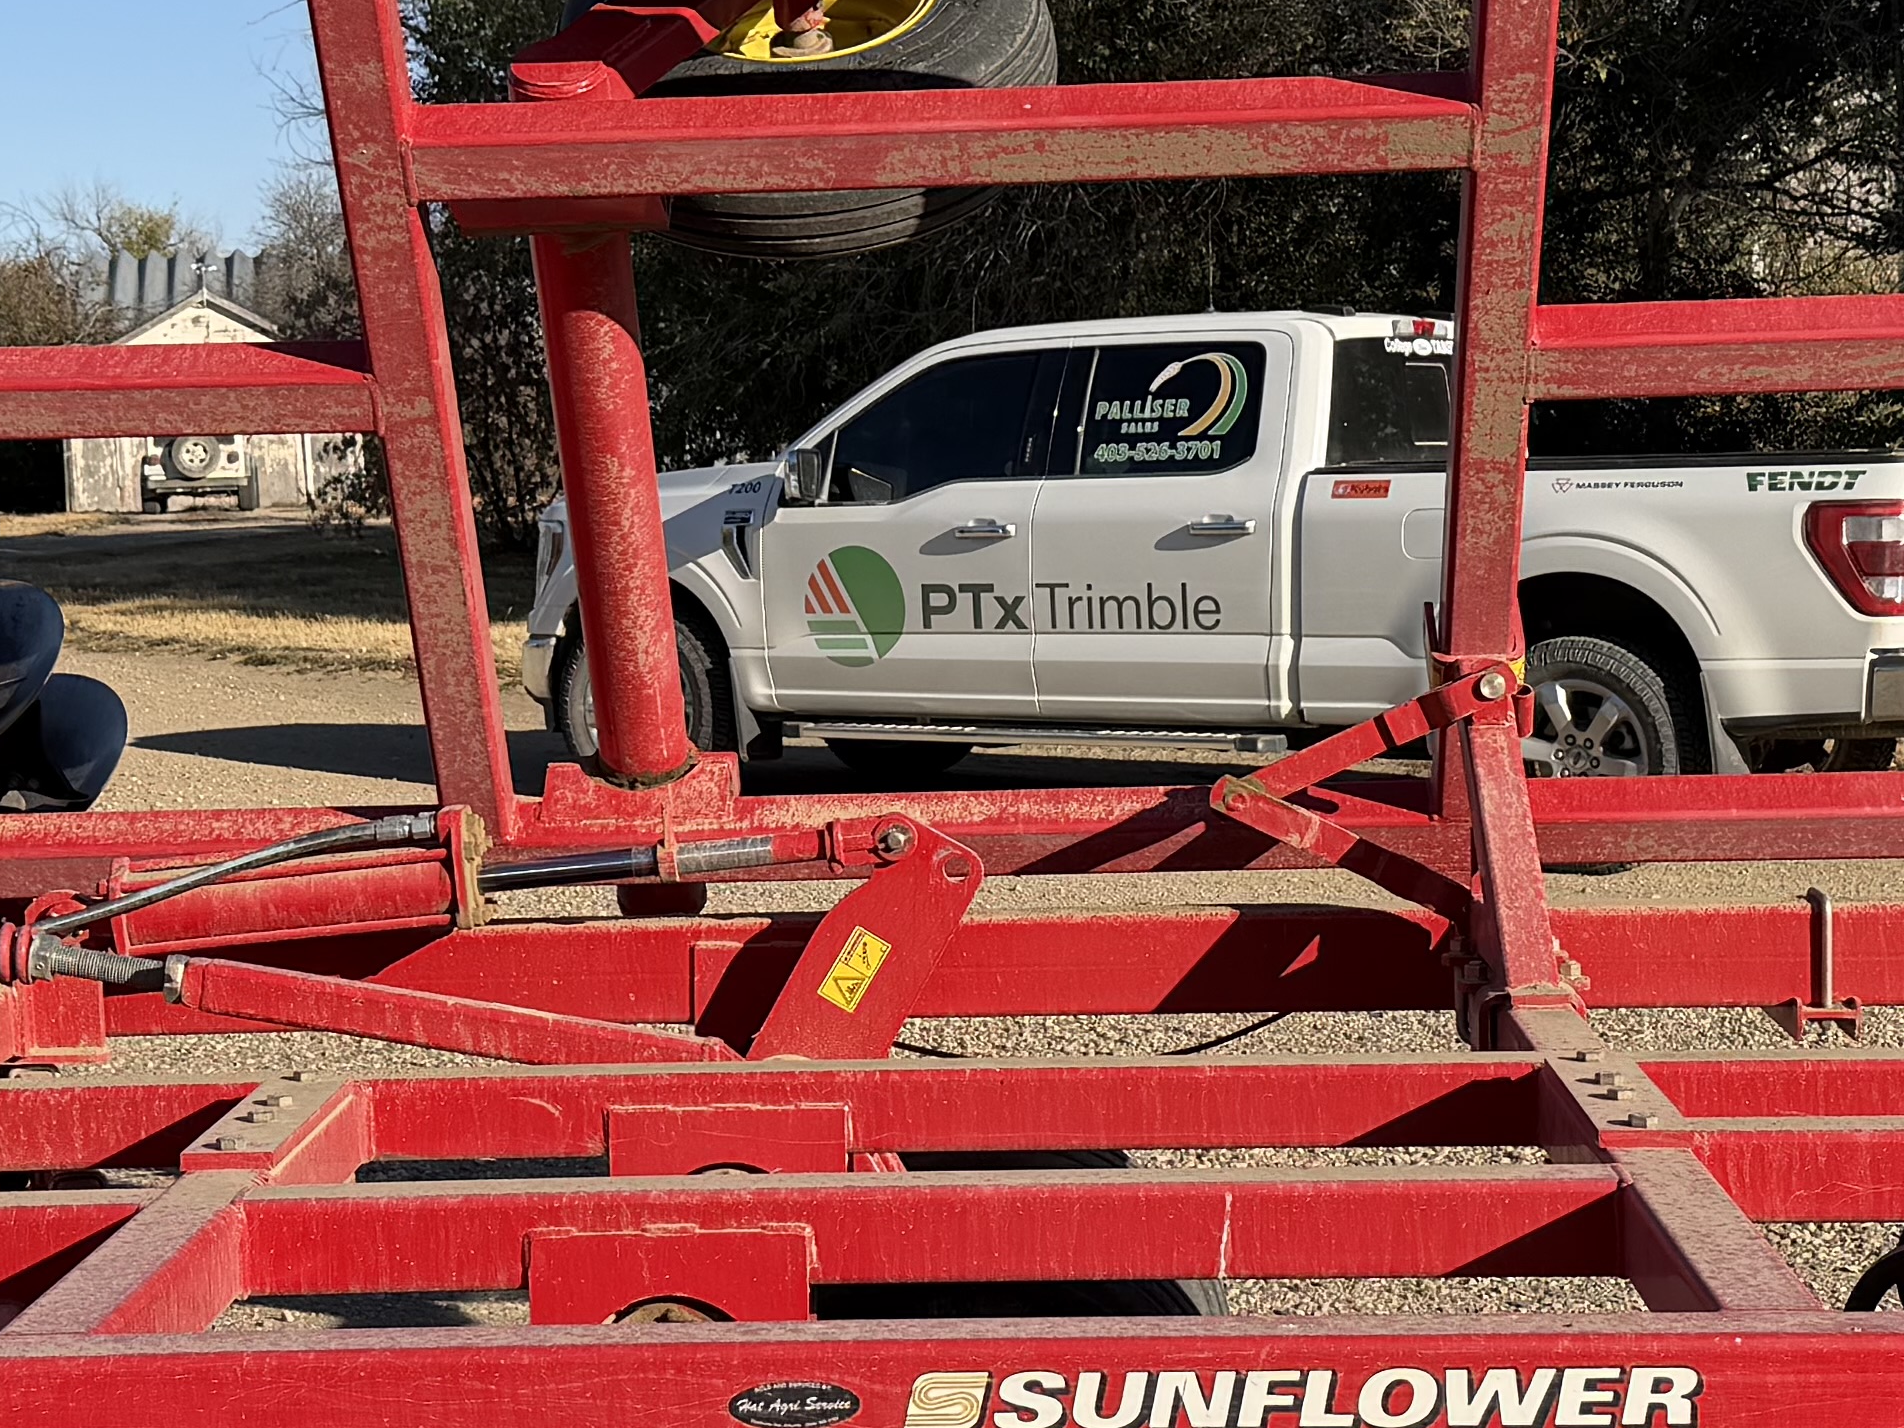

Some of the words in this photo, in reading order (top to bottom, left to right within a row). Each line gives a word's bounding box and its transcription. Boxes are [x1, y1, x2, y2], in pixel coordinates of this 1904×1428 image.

[1095, 395, 1190, 420] PALLISER
[1121, 421, 1159, 434] SALES
[1094, 440, 1221, 462] 403-526-3701
[1576, 481, 1621, 489] MASSEY
[1623, 480, 1684, 488] FERGUSON
[1746, 470, 1867, 492] FENDT
[920, 583, 1029, 630] PTx
[1034, 582, 1222, 631] Trimble
[735, 1398, 764, 1413] Hat
[768, 1397, 801, 1416] Agri
[804, 1396, 852, 1411] Service
